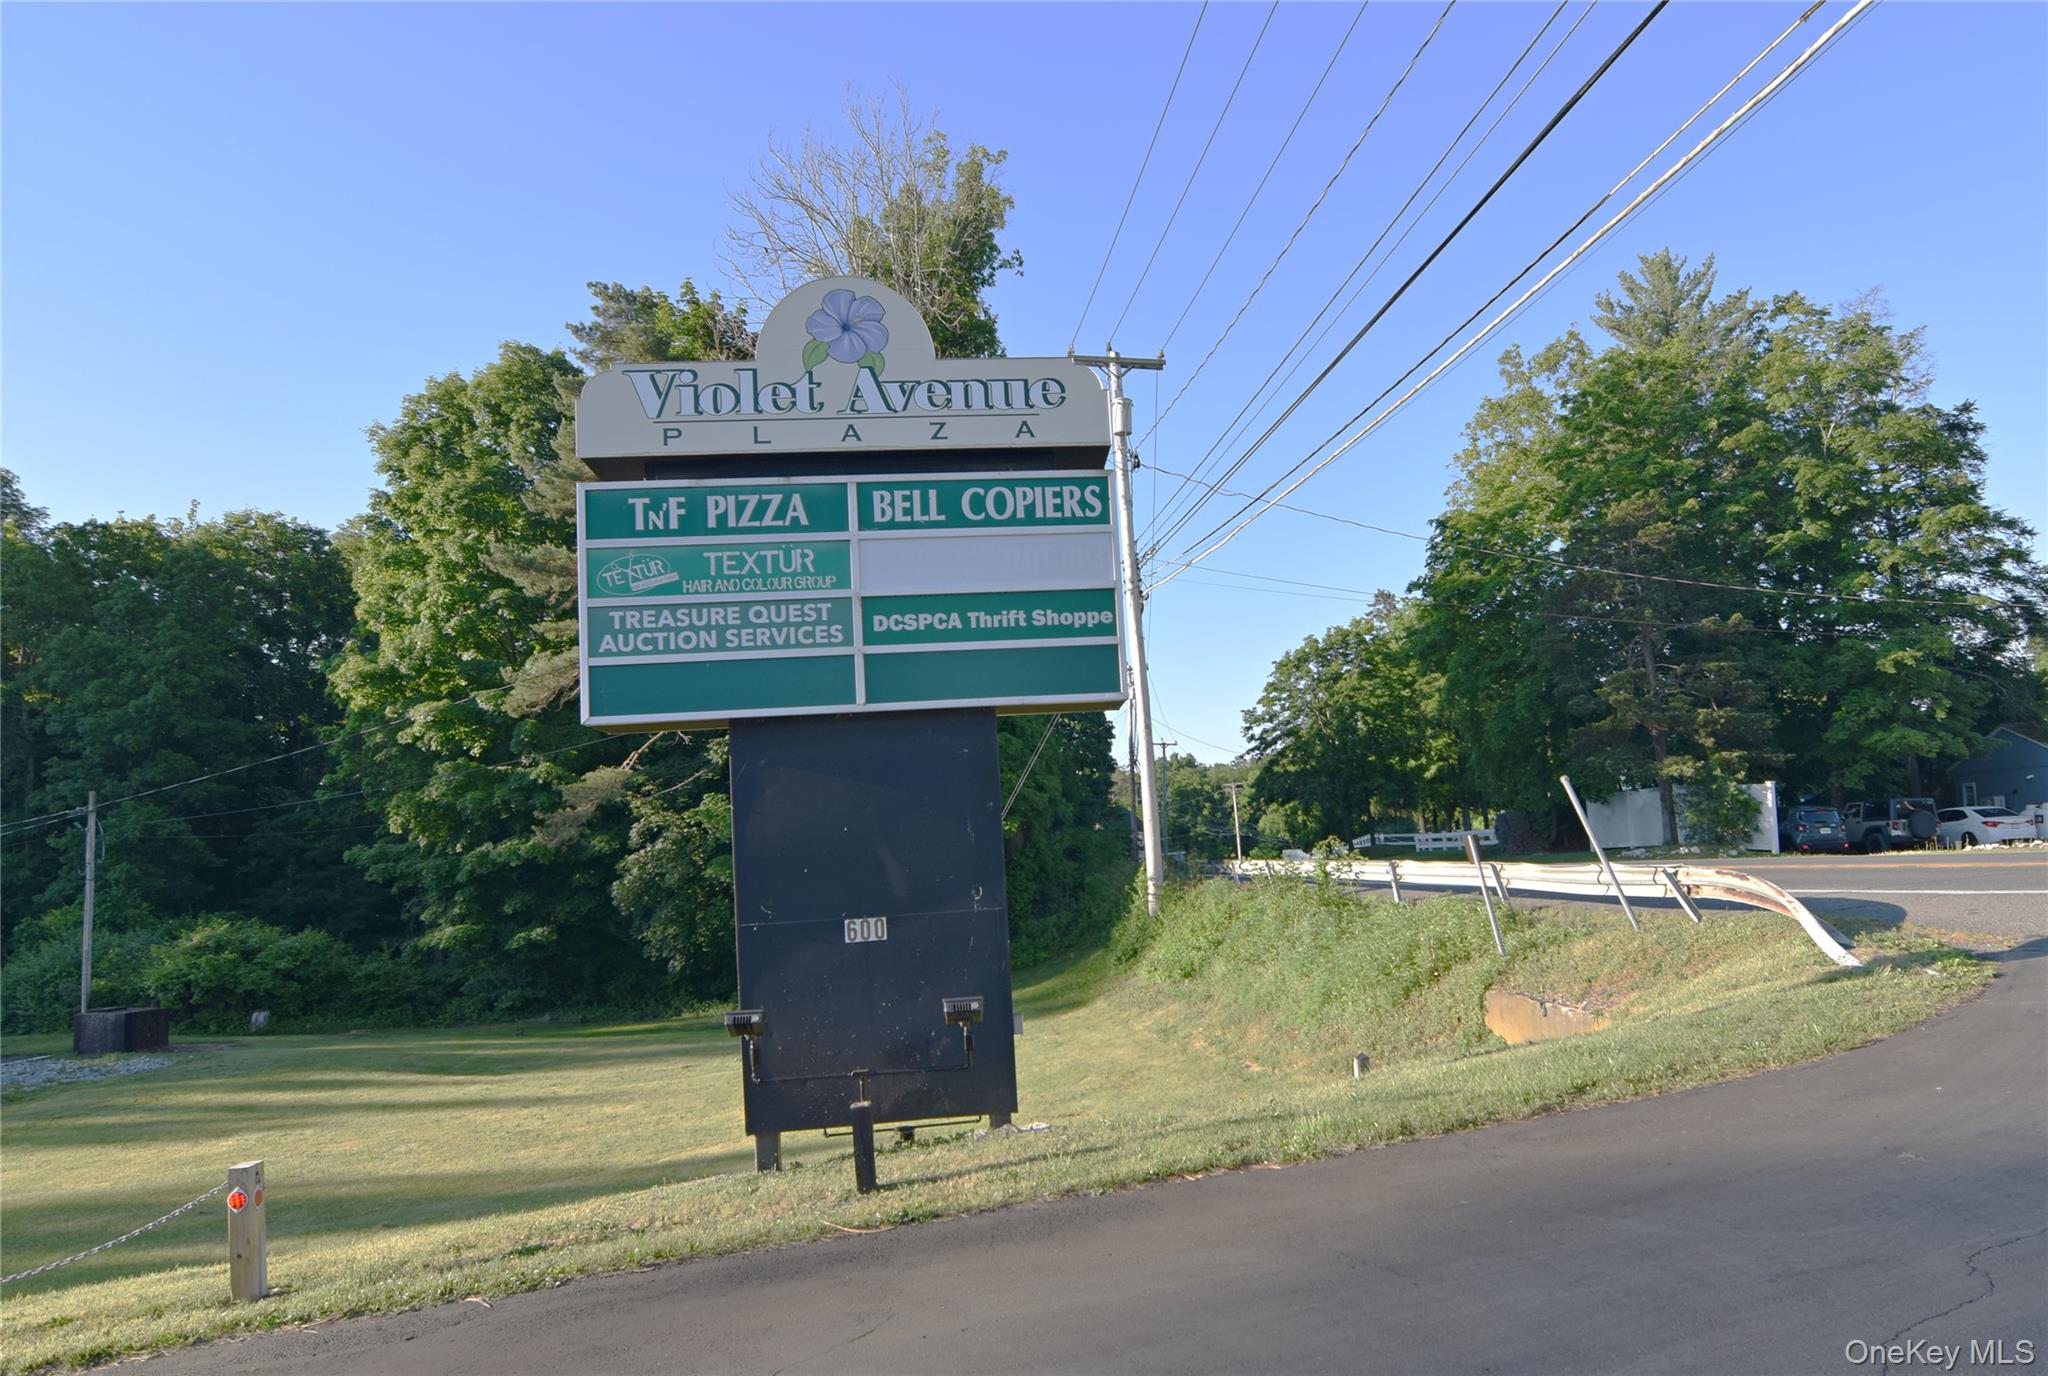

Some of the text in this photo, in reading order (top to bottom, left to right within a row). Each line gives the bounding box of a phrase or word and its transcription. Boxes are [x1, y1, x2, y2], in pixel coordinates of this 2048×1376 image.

[622, 366, 1066, 420] Violet Avenue
[663, 420, 1036, 448] PLAZA
[707, 494, 809, 528] PIZZA
[872, 485, 1102, 522] BELL COPIERS
[703, 544, 815, 576] TEXTÜR
[682, 577, 714, 593] HAIR
[714, 579, 741, 592] AND
[742, 576, 793, 591] COLOUR
[794, 575, 836, 590] GROUP
[609, 602, 832, 630] TREASURE QUEST
[873, 609, 1113, 632] DCSPCA Thrift Shoppe
[598, 624, 844, 653] AUCTION SERVICES
[847, 918, 885, 941] 600
